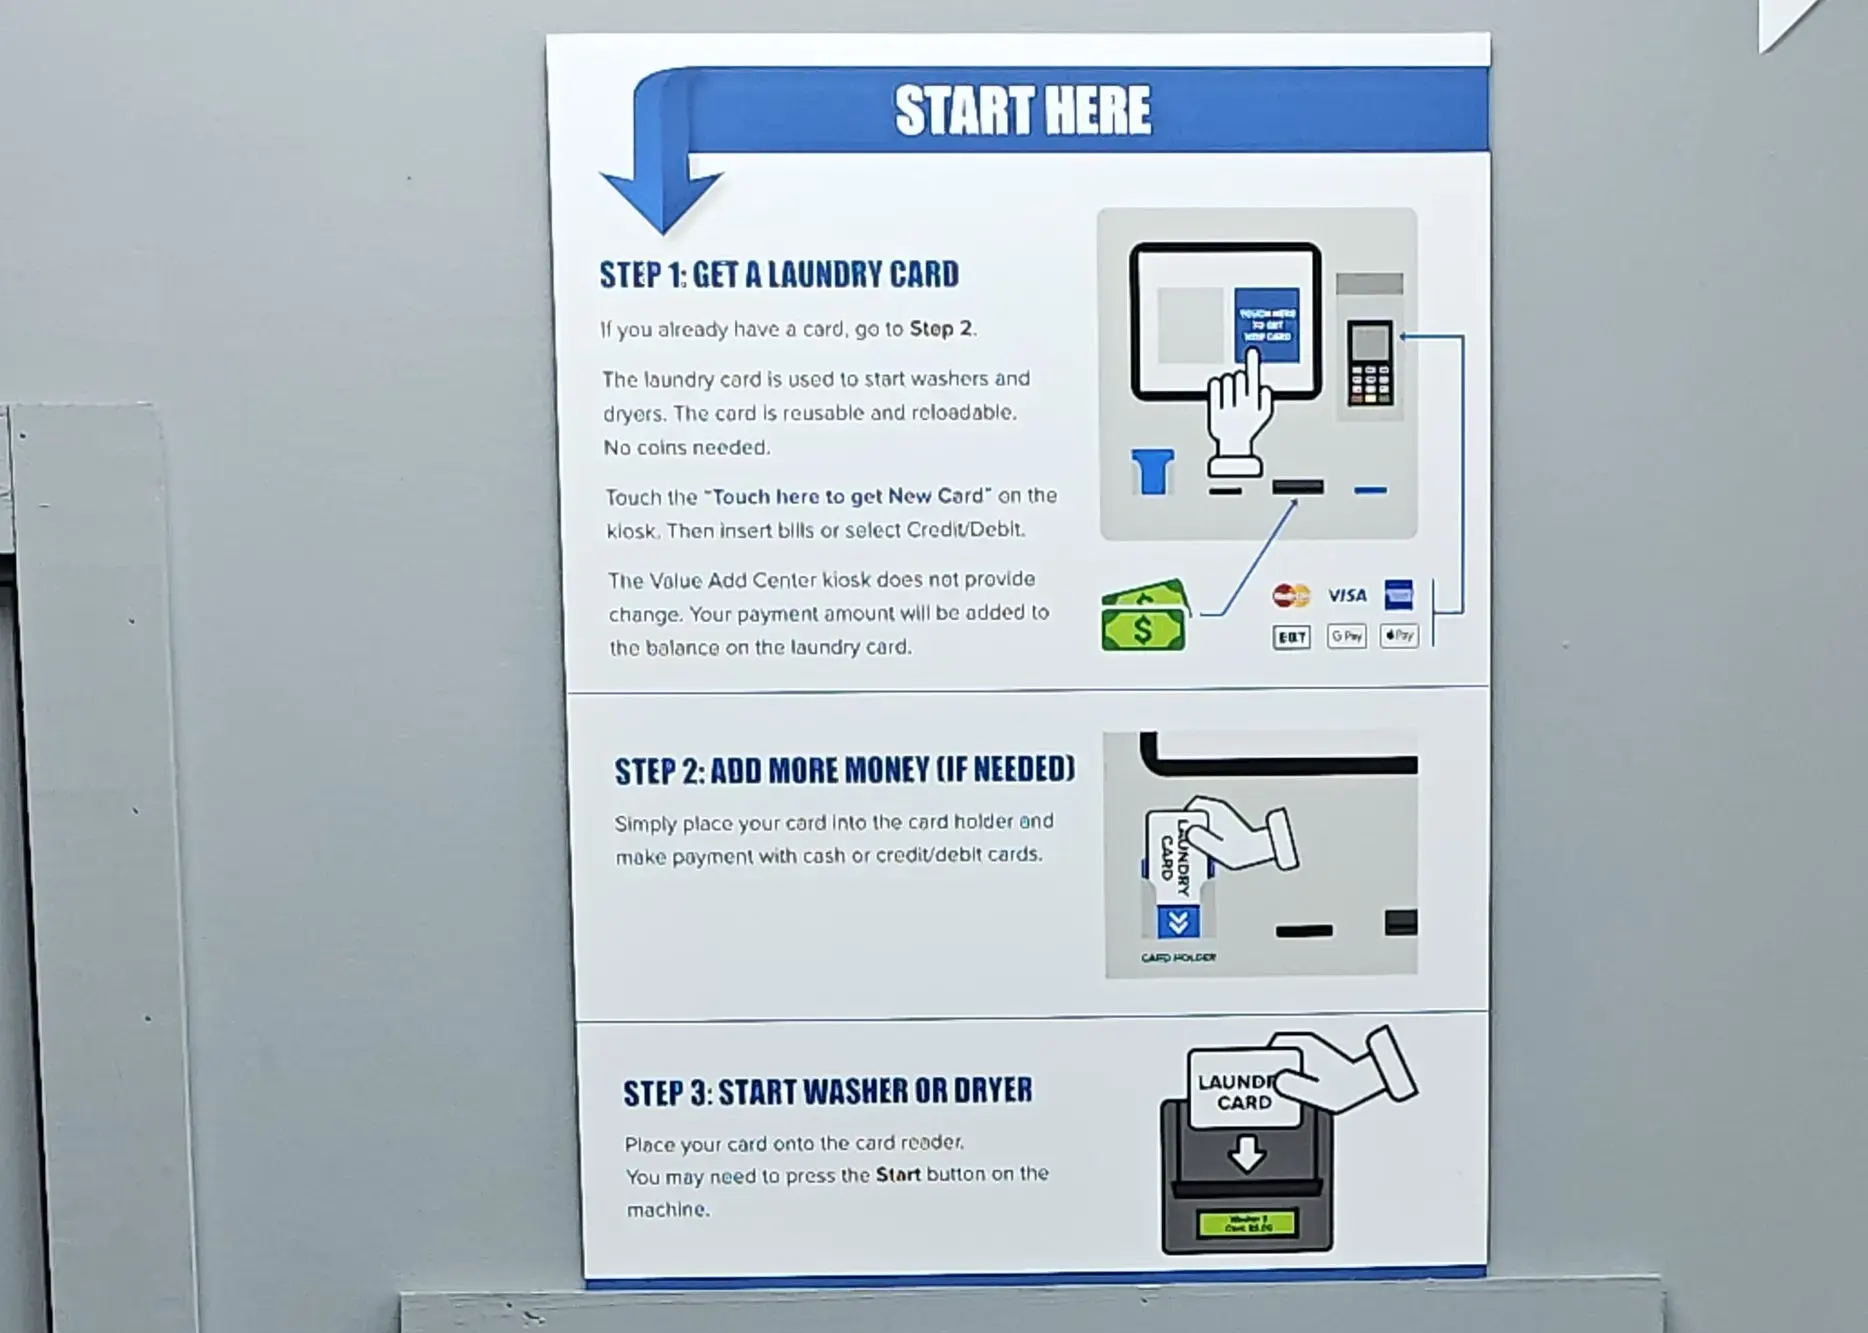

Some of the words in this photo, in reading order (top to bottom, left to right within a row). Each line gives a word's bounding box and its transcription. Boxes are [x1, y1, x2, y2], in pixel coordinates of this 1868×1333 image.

[896, 83, 1036, 136] START
[1045, 85, 1152, 136] HERE
[600, 259, 662, 289] STEP
[667, 261, 687, 289] 1:
[692, 259, 740, 289] GET
[745, 259, 763, 289] A
[767, 259, 883, 289] LAUNDRY
[889, 259, 960, 289] CARD
[600, 319, 613, 339] If
[616, 324, 653, 343] you
[658, 319, 729, 343] already
[734, 319, 780, 338] have
[785, 323, 797, 338] a
[803, 319, 849, 339] card,
[854, 323, 880, 341] go
[885, 321, 905, 338] to
[909, 319, 954, 341] Step
[959, 319, 978, 337] 2.
[602, 370, 639, 389] The
[643, 370, 715, 393] laundry
[719, 370, 762, 389] card
[767, 370, 783, 389] is
[788, 370, 835, 389] used
[839, 371, 860, 388] to
[864, 370, 906, 388] start
[910, 368, 989, 387] washers
[994, 369, 1031, 387] and
[603, 439, 631, 456] No
[636, 439, 688, 456] coins
[692, 439, 771, 456] needed.
[605, 488, 662, 507] Touch
[667, 488, 698, 506] the
[776, 488, 820, 505] here
[825, 489, 845, 505] to
[850, 488, 883, 509] get
[888, 486, 933, 505] New
[997, 490, 1022, 505] on
[1027, 487, 1058, 505] the
[607, 522, 661, 540] kiosk.
[666, 522, 715, 539] Then
[720, 521, 773, 539] insert
[778, 521, 815, 539] bills
[819, 524, 840, 539] or
[845, 521, 901, 539] select
[906, 519, 1026, 539] Credit/Debit.
[1328, 588, 1368, 602] VISA
[1332, 630, 1342, 642] G
[1344, 630, 1363, 643] Pay
[1395, 628, 1415, 642] Pay
[614, 757, 676, 786] STEP
[682, 757, 706, 785] 2:
[710, 757, 762, 785] ADD
[768, 756, 840, 784] MORE
[845, 755, 931, 784] MONEY
[936, 755, 969, 783] (IF
[974, 754, 1076, 783] NEEDED)
[614, 815, 678, 837] Simply
[683, 815, 734, 837] place
[738, 818, 781, 836] your
[785, 813, 827, 832] card
[832, 813, 867, 832] into
[872, 813, 903, 831] the
[908, 813, 949, 831] card
[954, 812, 1014, 830] holder
[1019, 811, 1054, 830] and
[1161, 835, 1174, 881] CARD
[1141, 953, 1172, 964] CARD
[1172, 952, 1217, 963] HOLDER
[623, 1079, 684, 1107] STEP
[690, 1078, 713, 1107] 3:
[718, 1078, 798, 1106] START
[802, 1076, 909, 1106] WASHER
[914, 1076, 949, 1104] OR
[954, 1075, 1033, 1104] DRYER
[1198, 1074, 1277, 1091] LAUND
[1217, 1094, 1273, 1111] CARD
[625, 1136, 676, 1154] Place
[680, 1140, 722, 1158] your
[727, 1135, 768, 1153] card
[773, 1136, 815, 1153] onto
[820, 1134, 850, 1152] the
[855, 1134, 896, 1151] card
[901, 1133, 965, 1151] reader.
